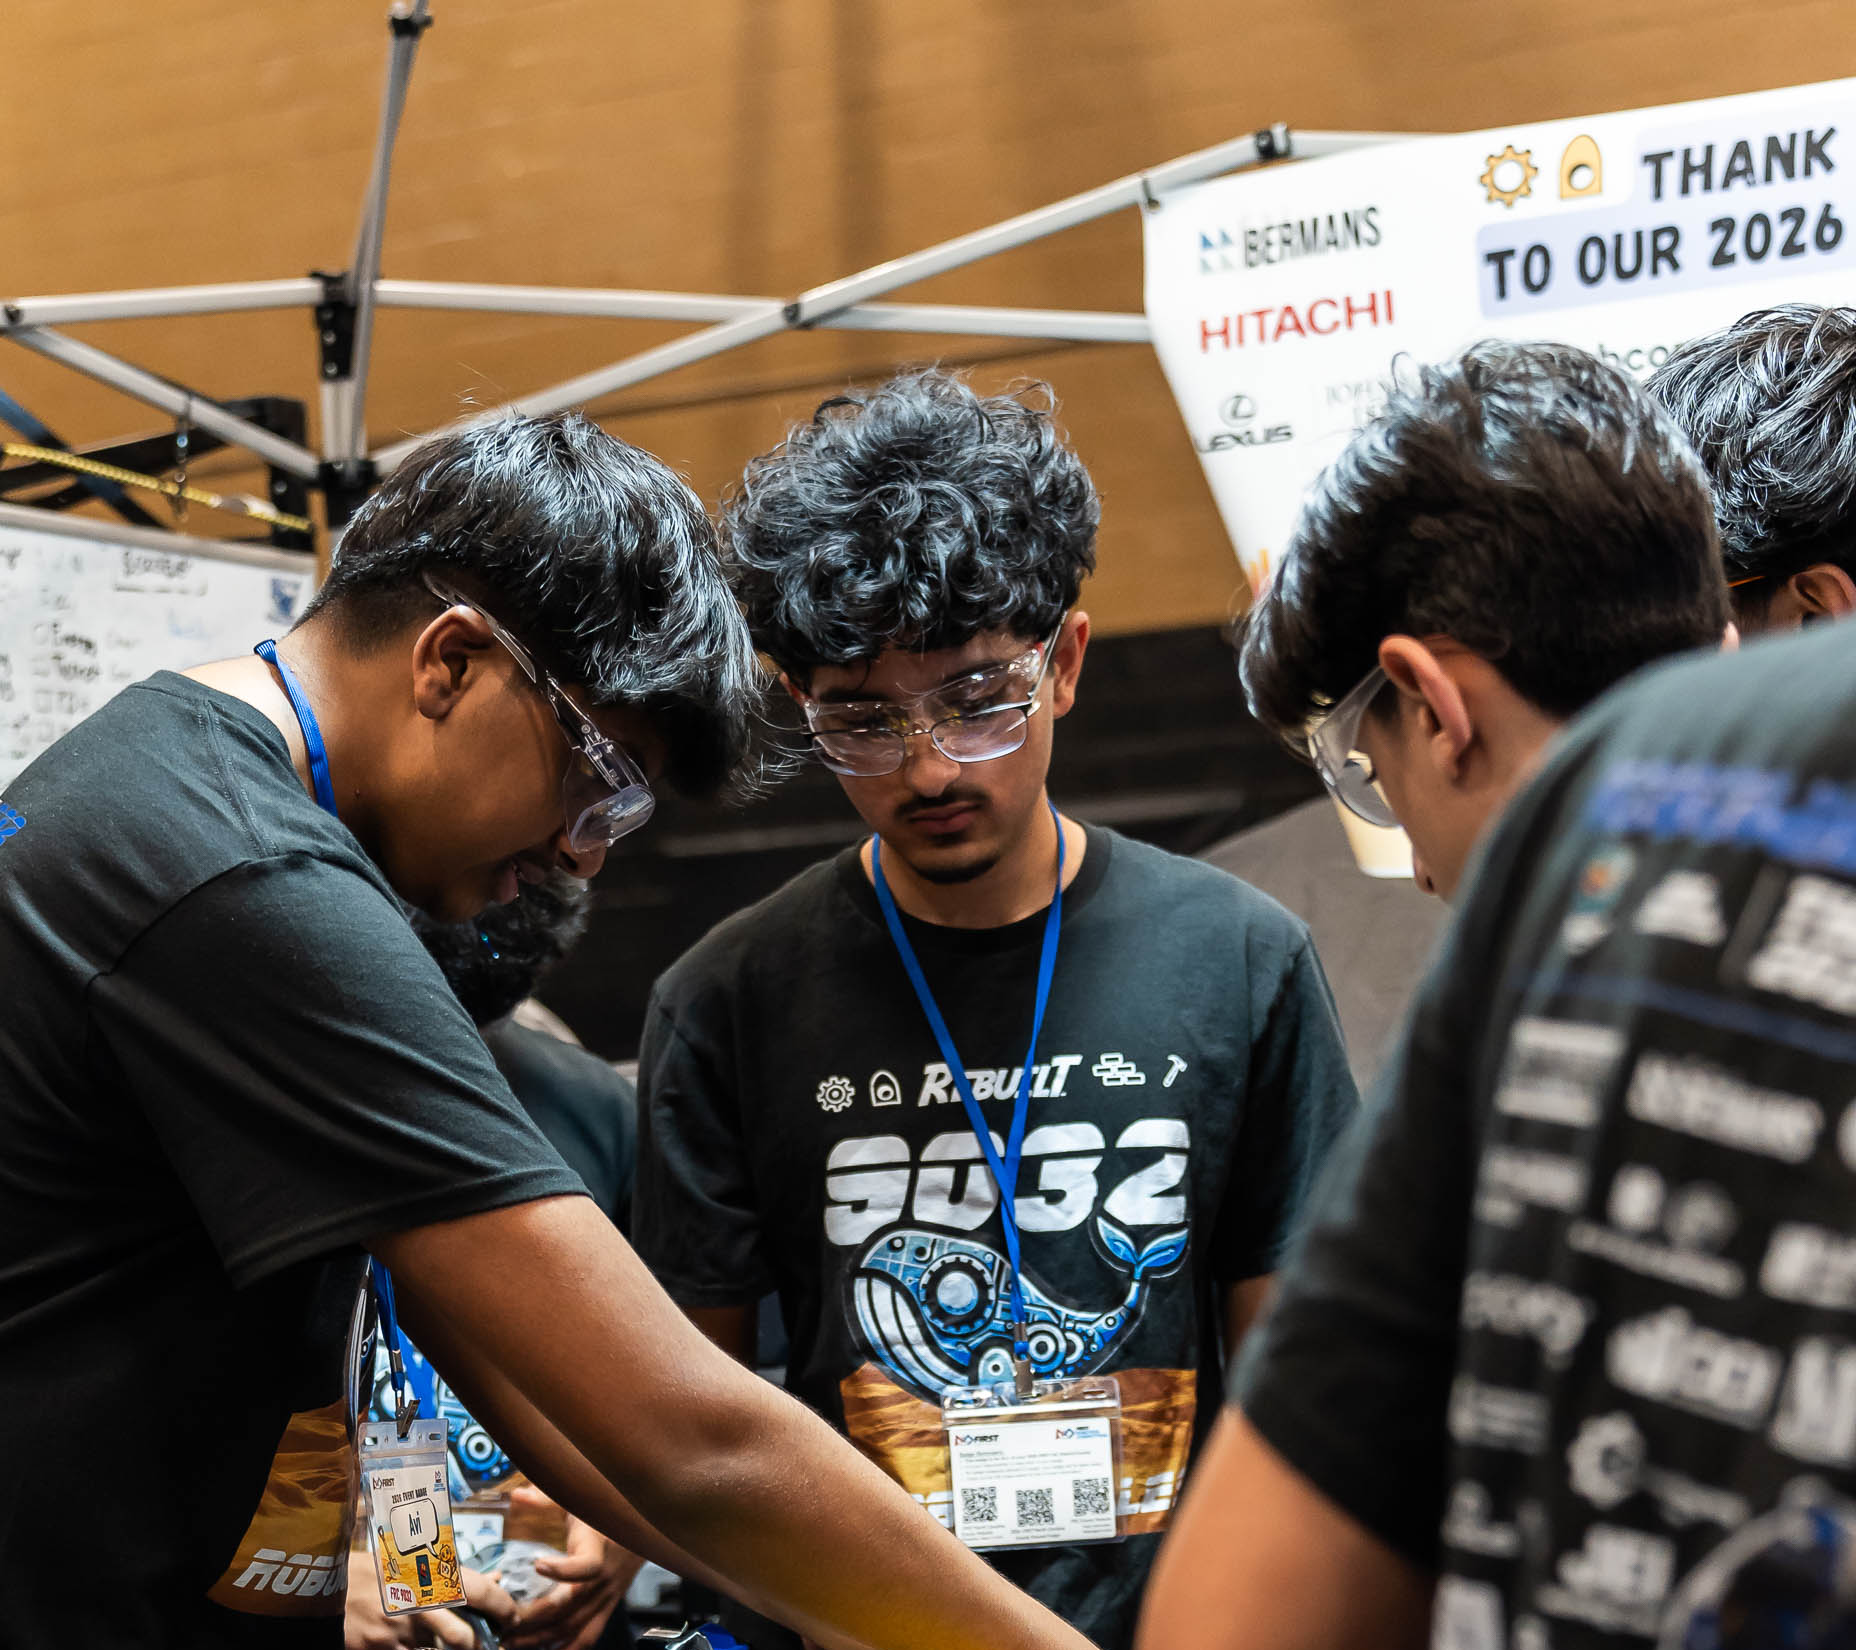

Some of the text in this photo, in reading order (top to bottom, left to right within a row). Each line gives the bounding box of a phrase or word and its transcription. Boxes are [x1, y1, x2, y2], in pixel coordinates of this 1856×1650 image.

[1642, 127, 1836, 200] THANK
[1244, 206, 1382, 269] BERMANS
[1485, 203, 1844, 300] TO OUR 2026
[1200, 290, 1394, 353] HITACHI
[918, 1054, 1083, 1107] RBULT
[823, 1117, 1191, 1246] 9032
[973, 1434, 999, 1443] FIRST
[408, 1511, 422, 1537] Avi
